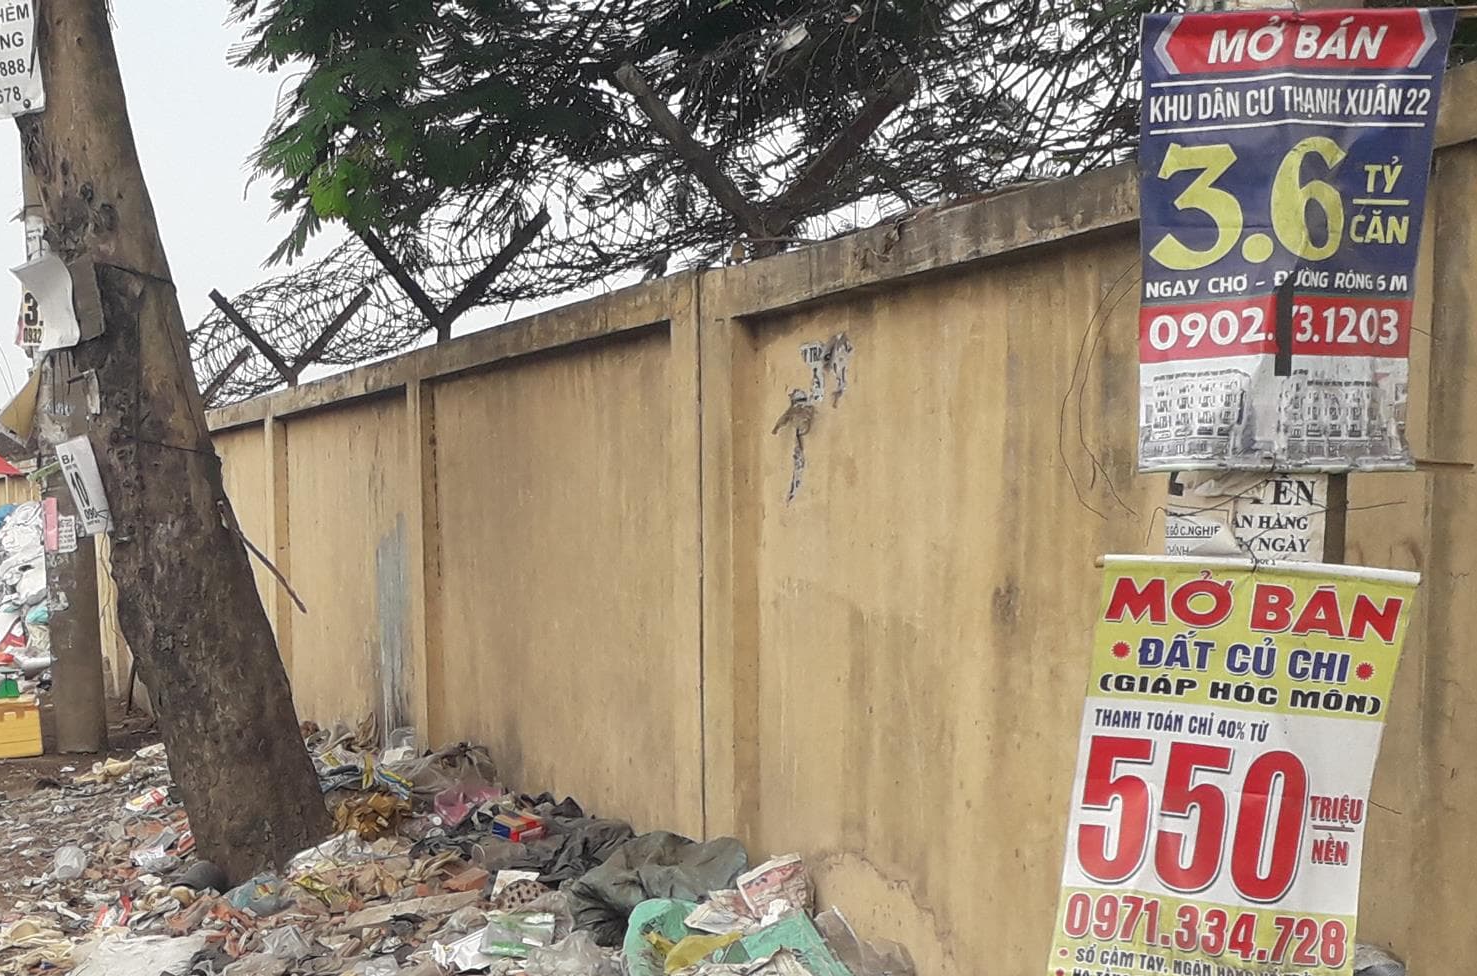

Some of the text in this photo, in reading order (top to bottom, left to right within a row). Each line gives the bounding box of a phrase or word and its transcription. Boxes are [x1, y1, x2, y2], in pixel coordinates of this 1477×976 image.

[1208, 16, 1388, 64] MỞ BÁN
[1149, 95, 1193, 123] KHU
[1197, 88, 1241, 120] DÂN
[1245, 85, 1276, 117] CƯ
[1344, 83, 1403, 116] XUÂN
[1404, 88, 1430, 116] 22
[1149, 136, 1348, 270] 3.6
[1350, 207, 1410, 246] CĂN
[1145, 277, 1200, 299] NGAY
[1208, 275, 1249, 296] CHỢ
[1334, 269, 1374, 293] RỘNG
[1376, 274, 1387, 291] 6
[1389, 275, 1408, 291] M
[1150, 305, 1399, 351] 0902.3.1203
[1258, 534, 1310, 552] NGÀY
[1104, 570, 1404, 645] MỞ BÁN
[1138, 631, 1351, 685] ĐẤT CỦ CHI
[1099, 673, 1382, 716] (GIÁP HÓC MÔN)
[1095, 708, 1142, 729] THANH
[1147, 711, 1184, 733] TOÁN
[1188, 712, 1215, 736] CHỈ
[1217, 719, 1247, 741] 40%
[1076, 735, 1309, 903] 550
[1310, 794, 1365, 827] TRIỆU
[1311, 832, 1350, 866] NỀN
[1063, 893, 1349, 969] 0971.334.728
